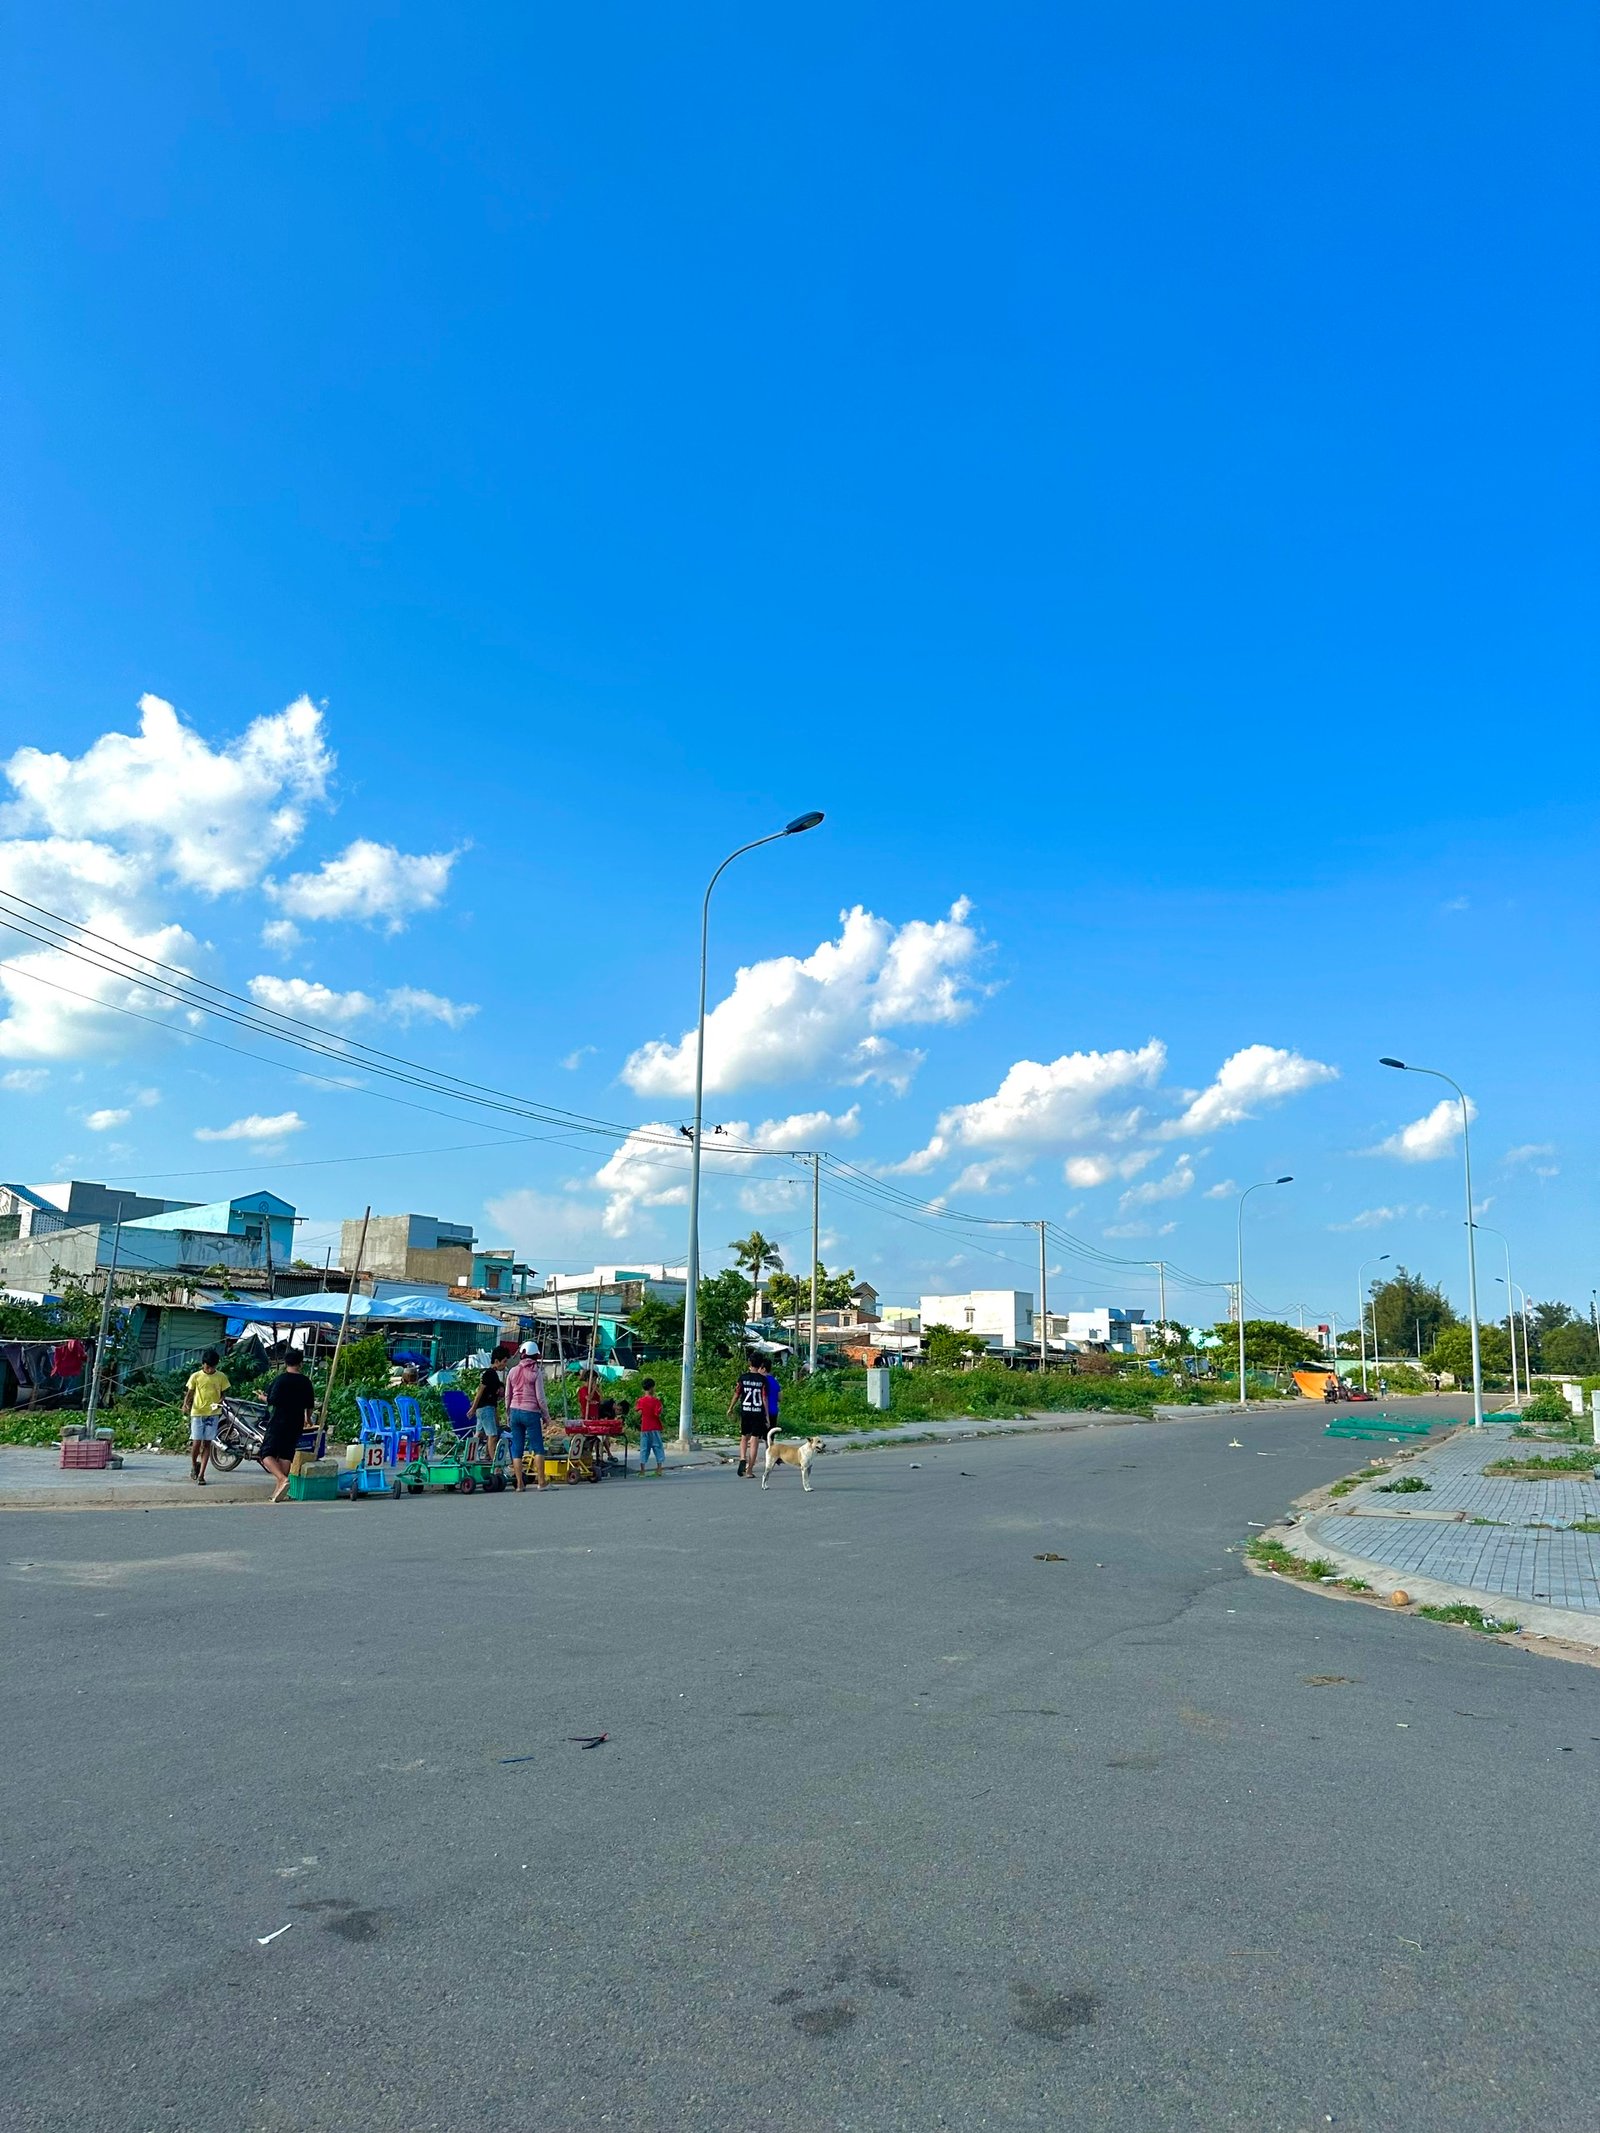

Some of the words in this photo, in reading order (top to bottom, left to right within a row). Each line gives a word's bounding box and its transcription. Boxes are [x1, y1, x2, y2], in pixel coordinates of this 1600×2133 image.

[743, 1388, 762, 1406] 20
[467, 1442, 476, 1461] 11
[498, 1443, 506, 1461] 6
[573, 1438, 581, 1456] 3
[368, 1449, 383, 1466] 13
